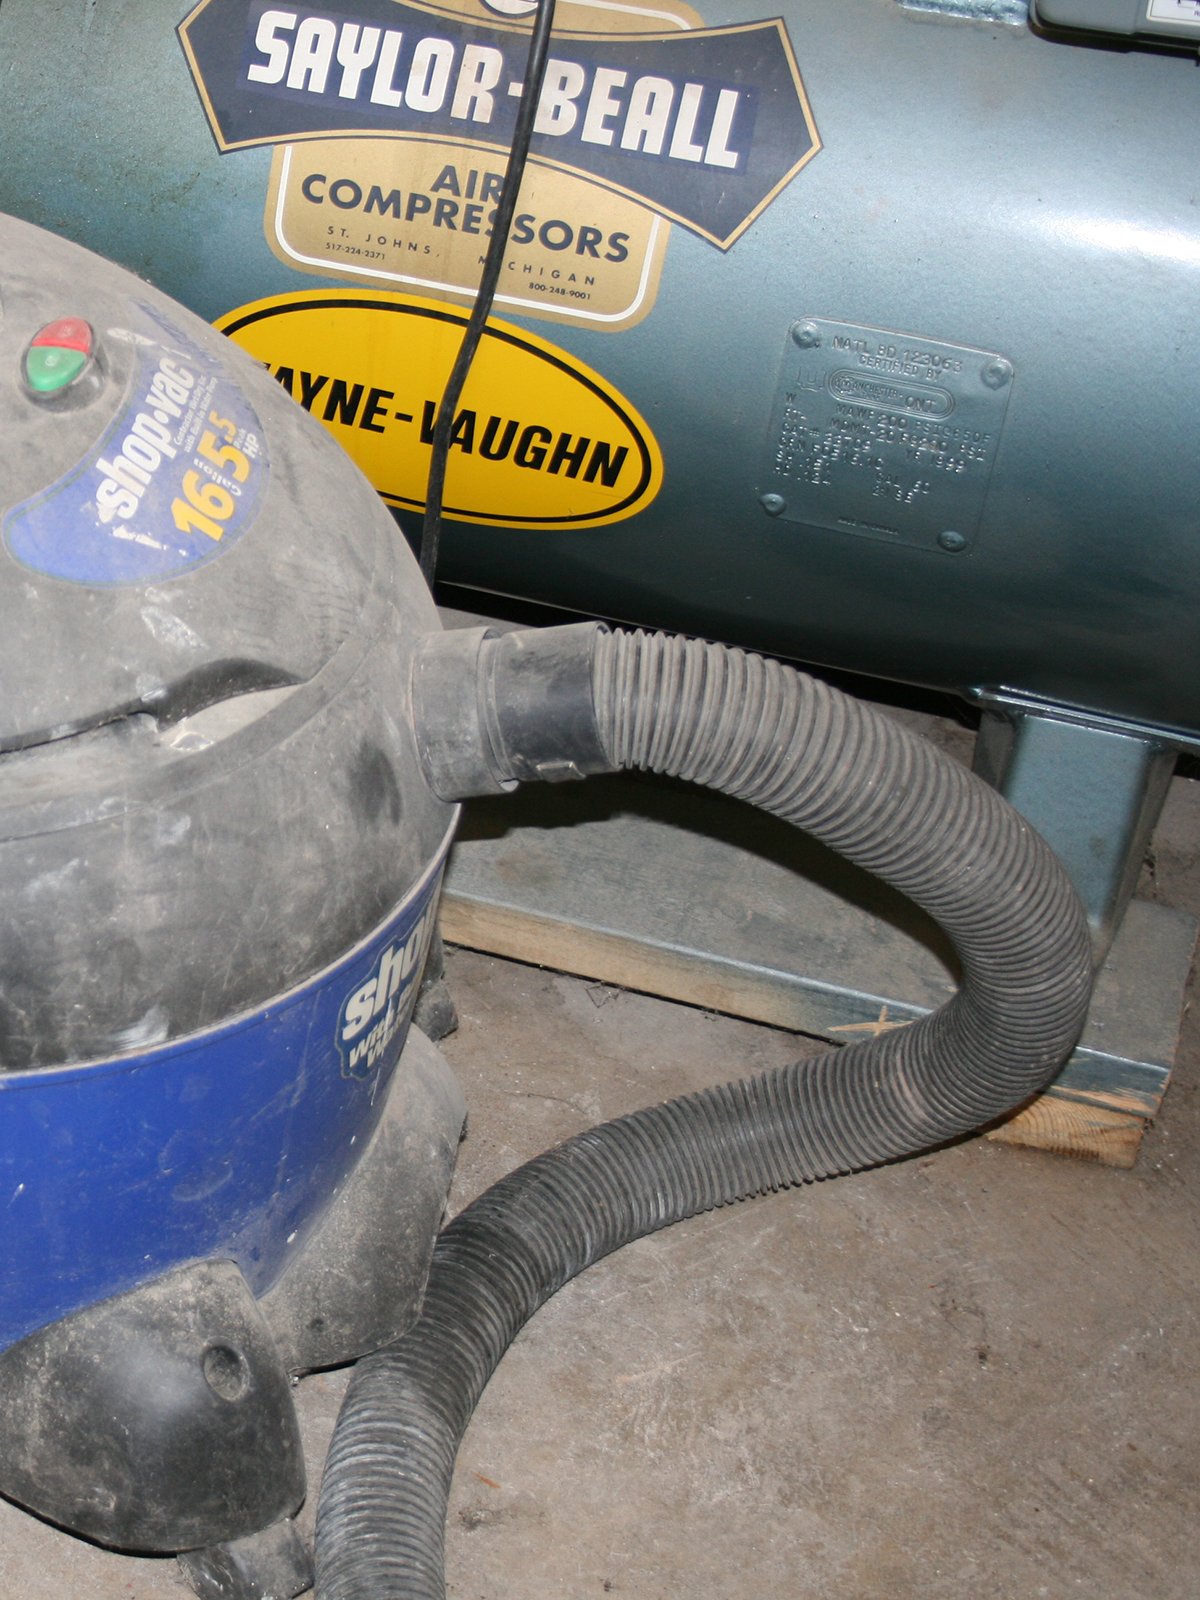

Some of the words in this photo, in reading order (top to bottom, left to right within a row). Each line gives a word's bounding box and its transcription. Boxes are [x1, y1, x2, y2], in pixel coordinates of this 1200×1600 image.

[246, 10, 740, 169] SAYLOR-BEALL
[430, 165, 506, 205] AIR
[325, 242, 386, 261] 517-224-2371
[327, 226, 350, 239] ST.
[365, 234, 440, 258] JOHNS,
[478, 255, 596, 286] MCHIGAN
[528, 281, 591, 301] 800-248-9001
[858, 354, 919, 377] CERTIFIED
[926, 368, 943, 382] BY
[876, 413, 909, 432] 200
[903, 395, 936, 414] ONT
[264, 362, 630, 488] AYNE-VAUGHN
[193, 458, 242, 497] Gallon
[171, 469, 235, 543] 16
